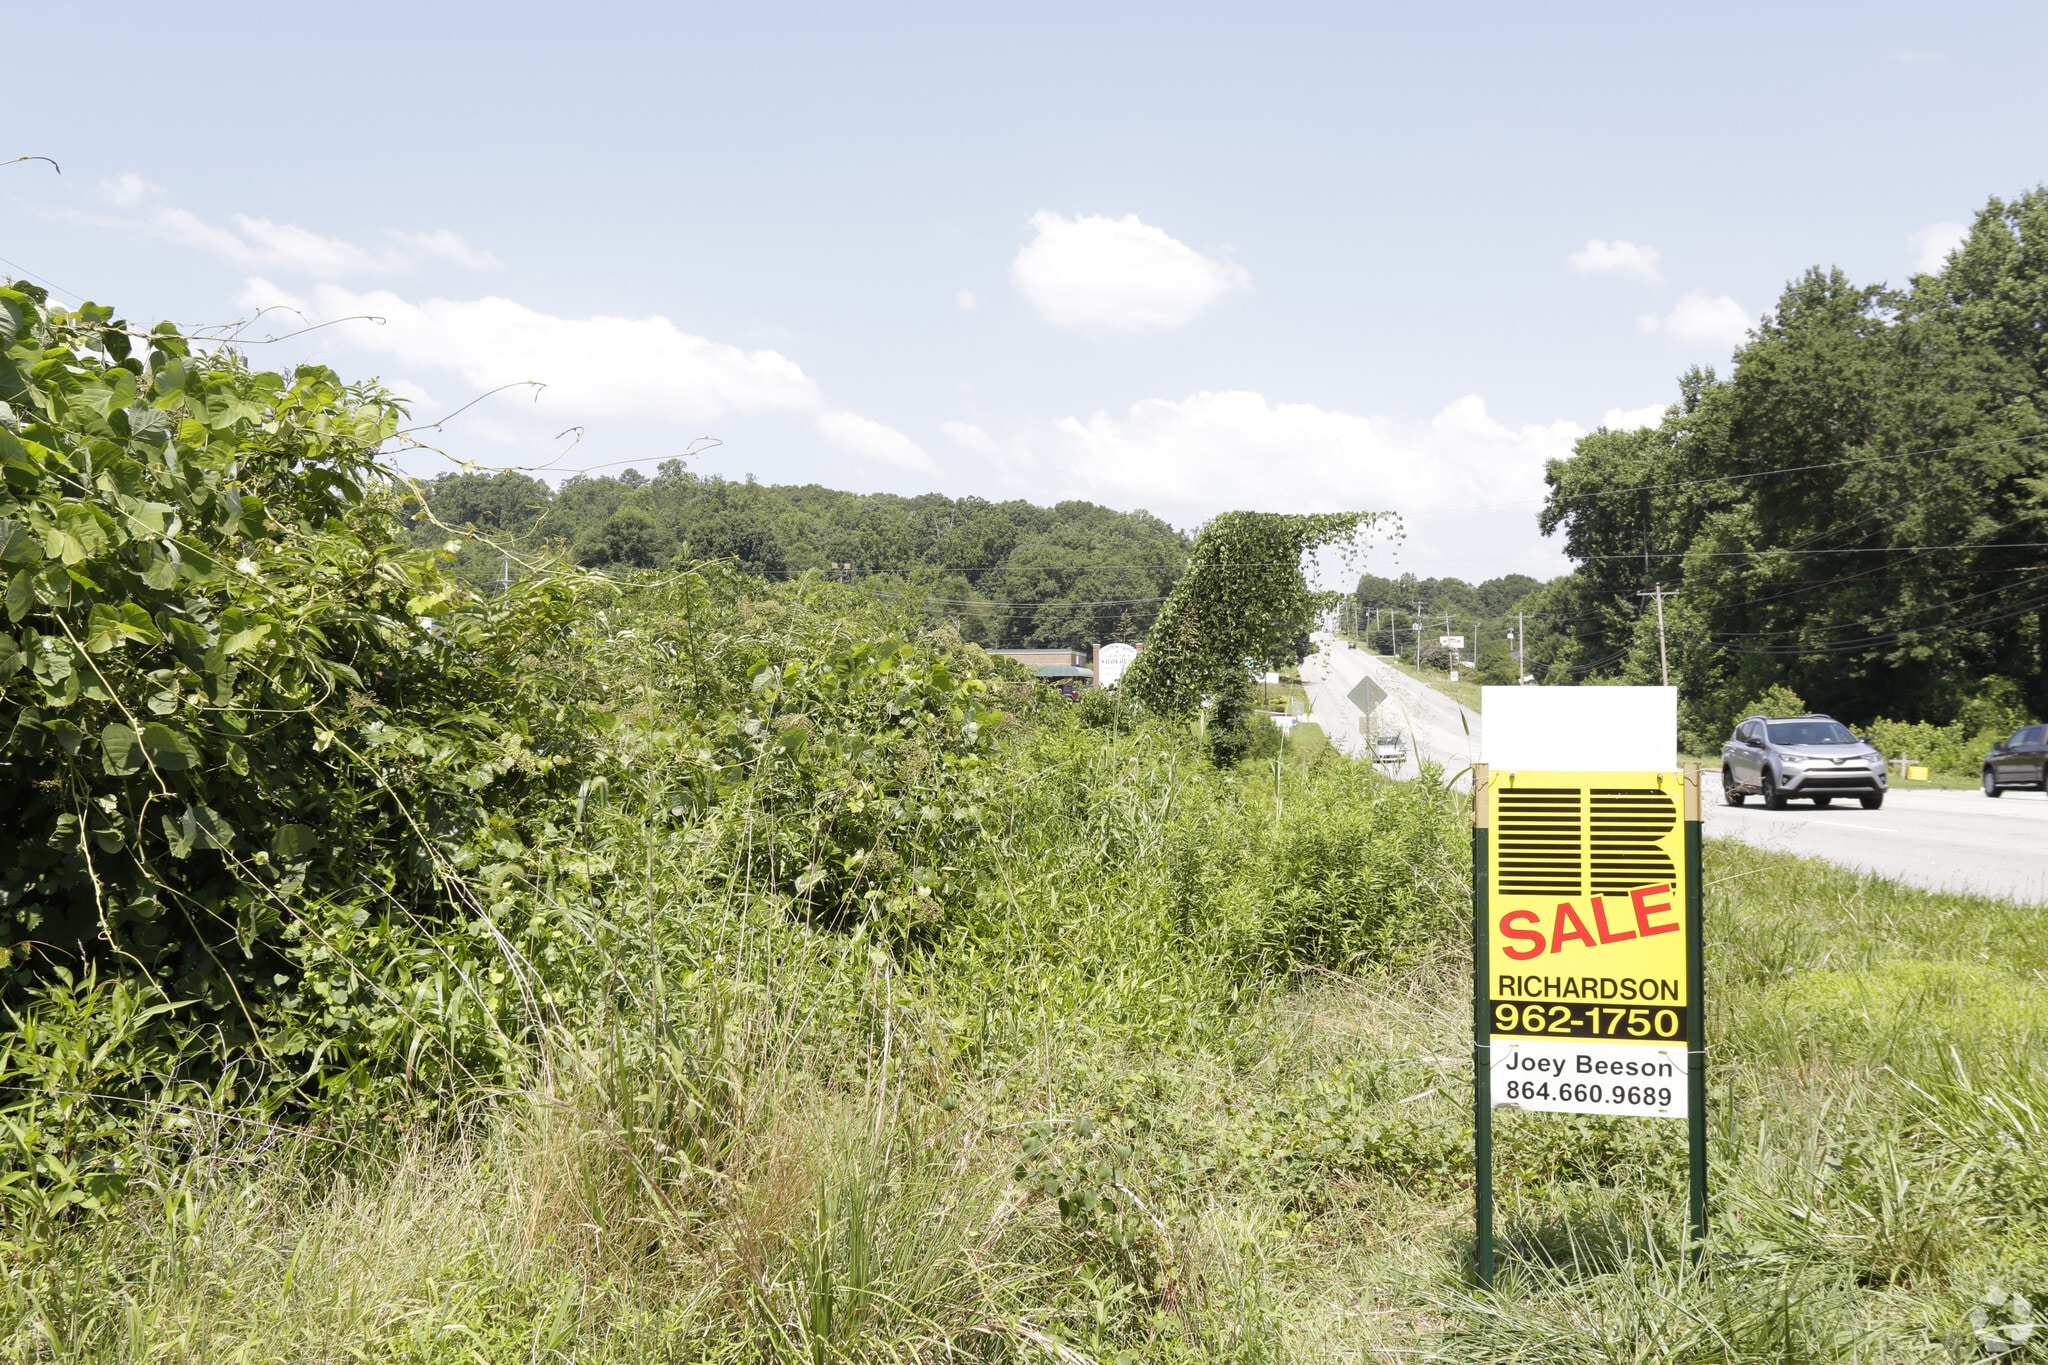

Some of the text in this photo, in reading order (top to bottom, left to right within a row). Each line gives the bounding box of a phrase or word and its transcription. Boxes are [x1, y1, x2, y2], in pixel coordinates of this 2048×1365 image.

[1499, 883, 1680, 961] SALE
[1499, 975, 1679, 1001] RICHARDSON
[1495, 1003, 1679, 1038] 962-1750
[1506, 1051, 1673, 1078] Joey Beeson
[1507, 1080, 1672, 1106] 864.660.9689
